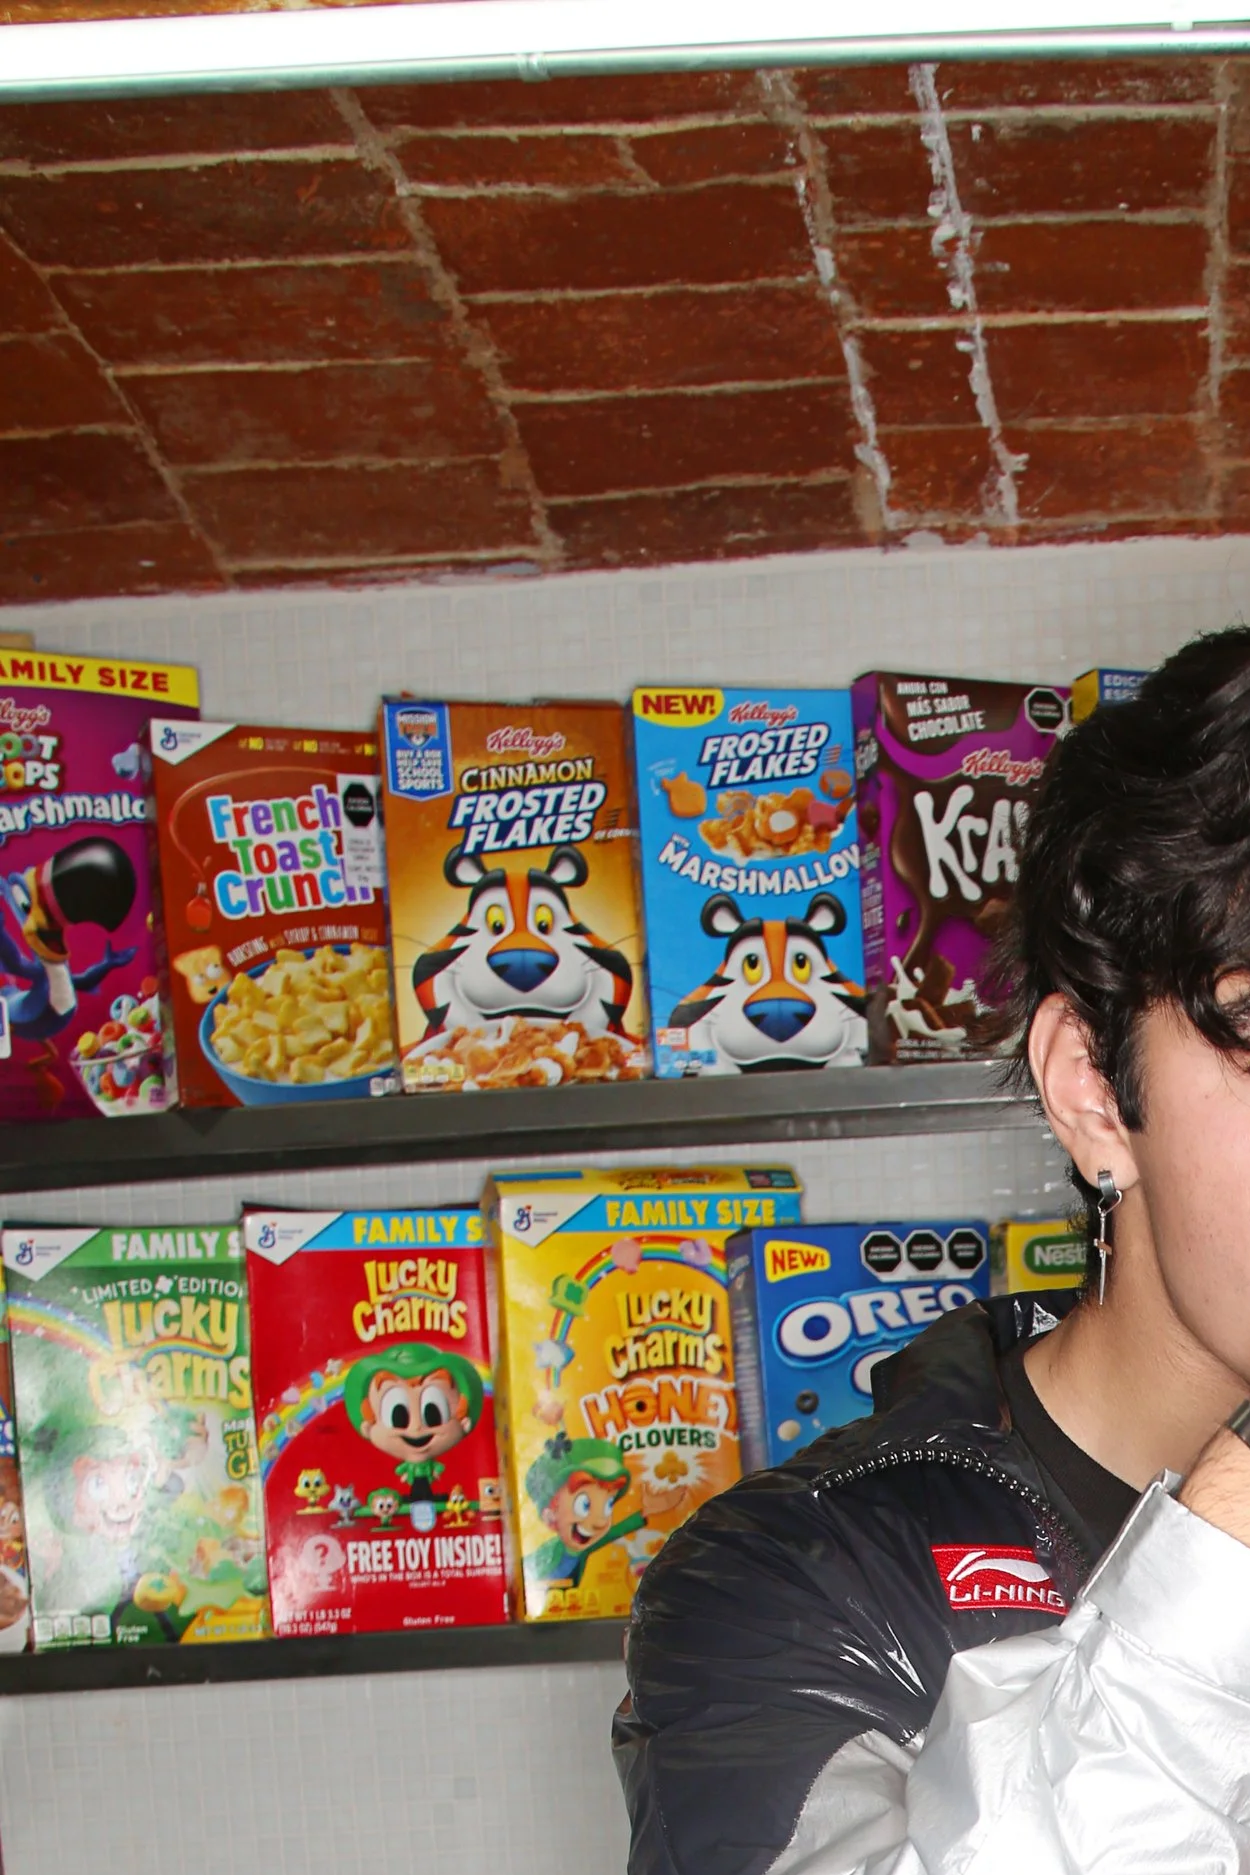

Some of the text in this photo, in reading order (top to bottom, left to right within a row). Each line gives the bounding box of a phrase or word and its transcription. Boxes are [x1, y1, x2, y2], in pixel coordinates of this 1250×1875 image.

[98, 667, 169, 692] SIZE
[641, 695, 716, 715] NEW!
[729, 701, 799, 726] Kellogg's
[907, 694, 970, 717] MÁS SABOR
[487, 726, 566, 757] Kellogg's
[907, 710, 987, 742] CHOCOLATE
[0, 732, 58, 760] OOT
[700, 724, 830, 764] FROSTED
[461, 758, 594, 793] CINNAMON
[709, 749, 819, 788] FLAKES
[963, 747, 1045, 785] Kellogg's
[398, 779, 444, 790] SPORTS
[0, 794, 147, 832] arshmallo
[209, 786, 342, 840] French
[451, 784, 606, 827] FROSTED
[463, 812, 595, 853] FLAKES
[232, 829, 339, 875] Toast
[606, 1198, 775, 1227] FAMILY SIZE
[112, 1232, 220, 1261] FAMILY
[353, 1216, 459, 1246] FAMILY
[771, 1250, 827, 1276] NEW!
[1034, 1244, 1086, 1267] Nest
[82, 1278, 152, 1304] LIMITED
[363, 1257, 459, 1304] Lucky
[103, 1295, 239, 1360] Lucky
[353, 1298, 468, 1342] Charms
[615, 1286, 714, 1340] Lucky
[777, 1284, 978, 1359] OREO
[604, 1330, 726, 1380] Charms
[88, 1350, 250, 1417] Charms
[617, 1428, 718, 1453] CLOVERS
[347, 1534, 502, 1573] FREE TOY INSIDE!
[350, 1573, 377, 1583] WHO'S
[379, 1572, 388, 1582] IN
[389, 1571, 404, 1581] THE
[406, 1570, 422, 1581] BOX
[423, 1570, 431, 1579] IS
[431, 1569, 439, 1578] A
[440, 1568, 464, 1578] TOTAL
[950, 1584, 1066, 1608] LI-NING
[403, 1614, 455, 1627] Gluten Free
[117, 1634, 140, 1644] Free
